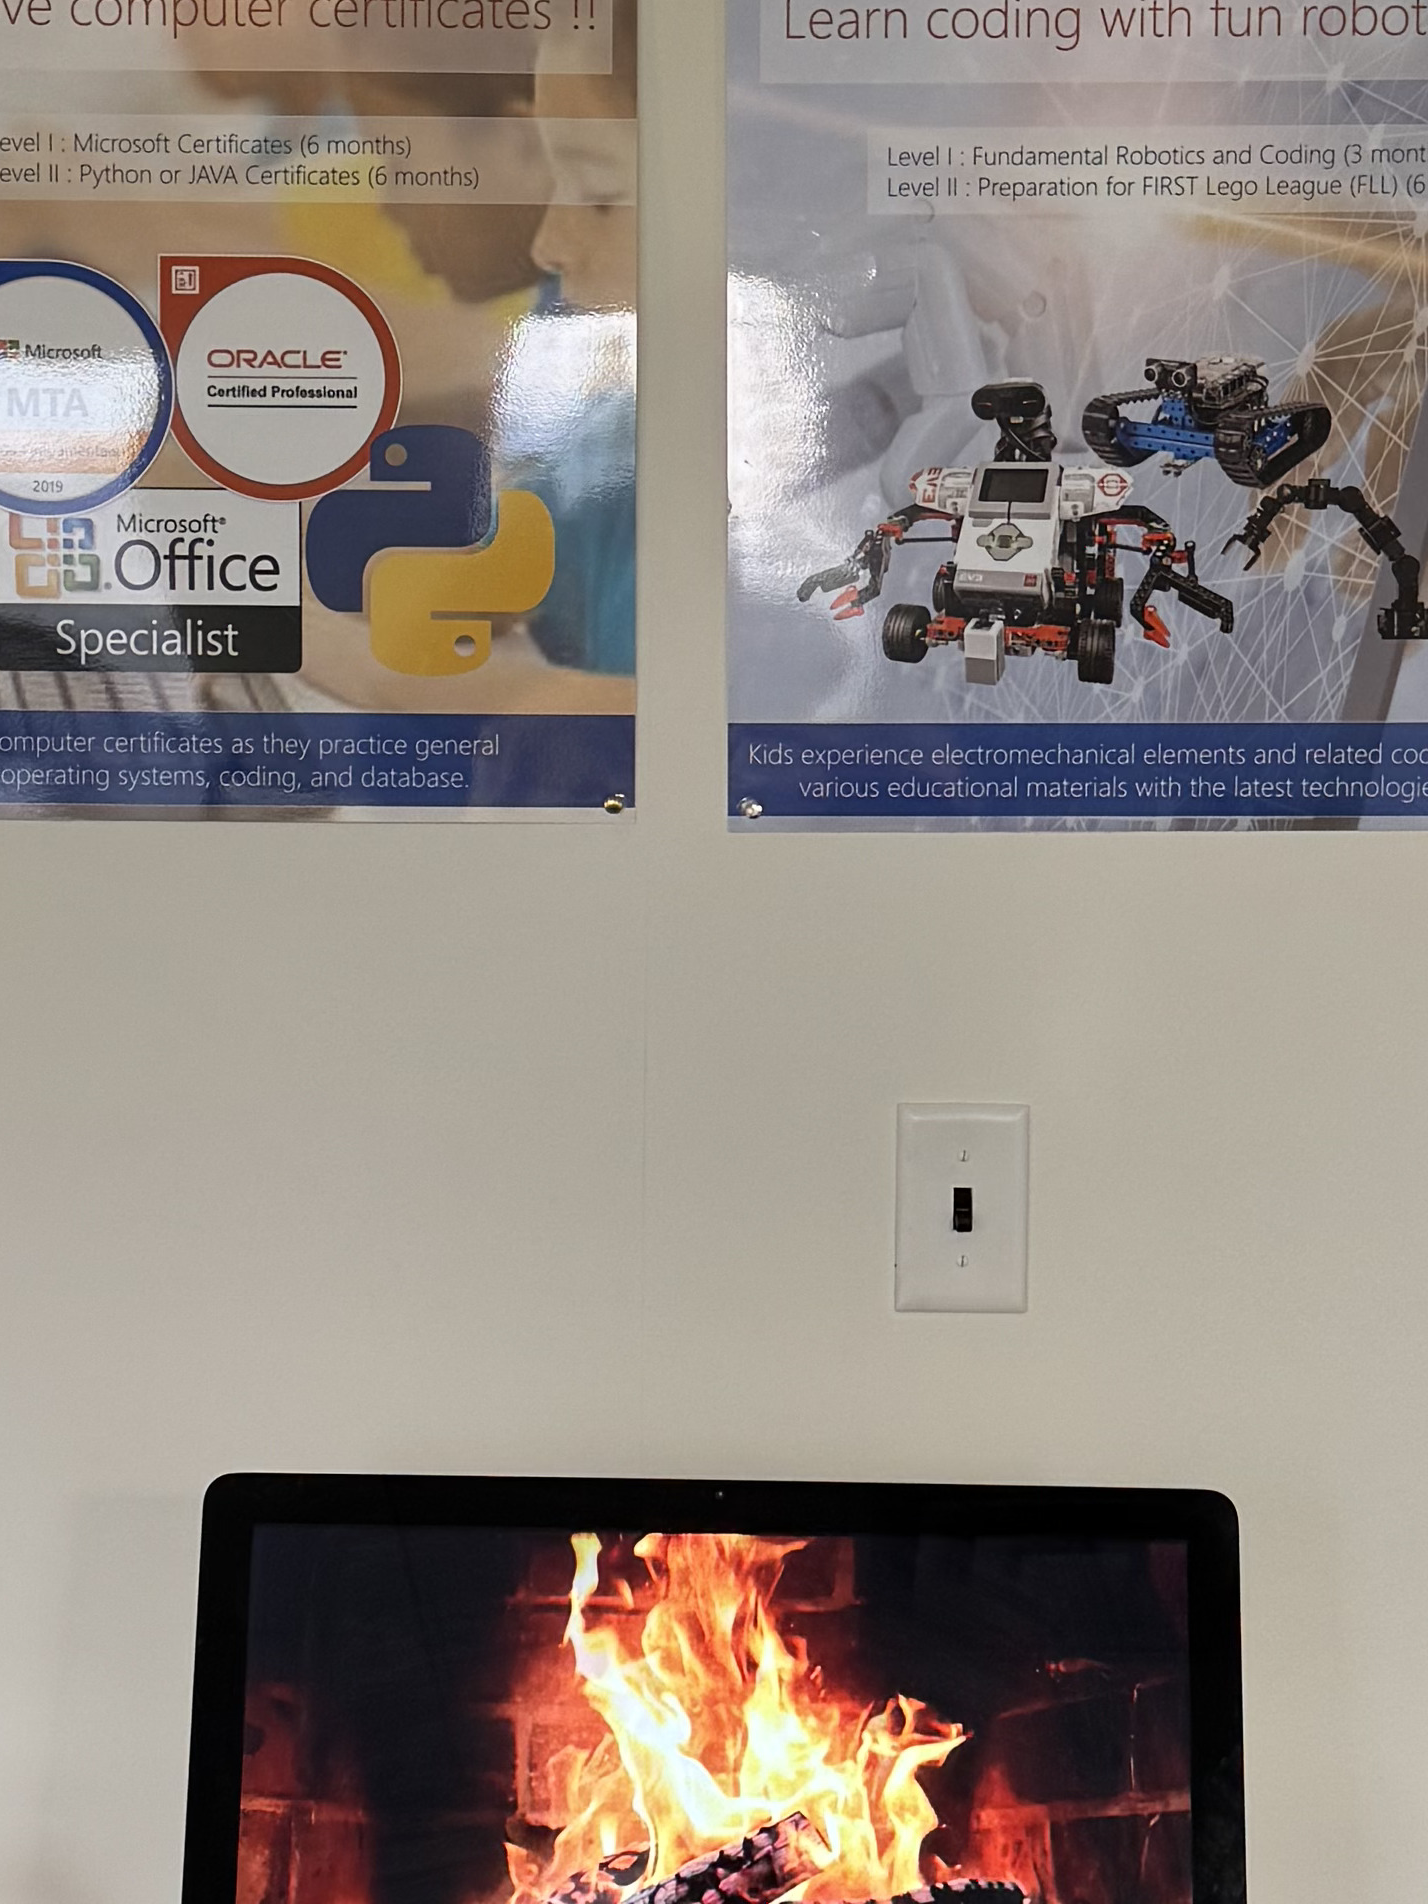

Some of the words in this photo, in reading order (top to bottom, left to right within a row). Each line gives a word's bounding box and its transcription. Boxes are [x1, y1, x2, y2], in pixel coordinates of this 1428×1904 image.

[48, 132, 53, 152] I
[73, 132, 171, 154] Microsoft
[177, 132, 293, 155] Certificates
[300, 134, 320, 159] (6
[326, 134, 412, 159] months)
[887, 145, 940, 167] Level
[947, 146, 952, 166] I
[972, 144, 1109, 167] Fundamental
[1116, 144, 1206, 166] Robotics
[1212, 144, 1252, 166] and
[1259, 143, 1336, 171] Coding
[1343, 143, 1363, 168] (3
[48, 163, 59, 183] II
[79, 163, 152, 190] Python
[159, 169, 182, 185] or
[188, 164, 239, 185] JAVA
[245, 163, 361, 186] Certificates
[367, 165, 388, 190] (6
[394, 166, 480, 190] months)
[887, 176, 940, 198] Level
[947, 177, 958, 197] II
[978, 176, 1098, 202] Preparation
[1105, 175, 1136, 197] for
[1142, 175, 1199, 197] FIRST
[1206, 175, 1259, 202] Lego
[1265, 175, 1343, 202] League
[1349, 174, 1398, 198] (FLL)
[1406, 173, 1426, 198] (6
[25, 342, 102, 361] Microsoft
[206, 348, 344, 370] ORACLE
[6, 387, 89, 418] MTA
[207, 385, 267, 399] Certified
[271, 385, 358, 400] Professional
[32, 479, 64, 494] 2019
[113, 537, 281, 593] Office
[55, 618, 240, 666] Specialist
[103, 730, 223, 754] certificates
[231, 737, 255, 755] as
[262, 732, 312, 761] they
[319, 736, 408, 760] practice
[415, 733, 499, 762] general
[749, 742, 794, 765] Kids
[801, 743, 924, 771] experience
[931, 742, 1135, 766] electromechanical
[1143, 742, 1246, 765] elements
[1253, 742, 1297, 765] and
[1305, 742, 1383, 765] related
[0, 766, 110, 792] operating
[118, 767, 210, 792] systems,
[219, 764, 302, 794] coding,
[310, 764, 353, 788] and
[360, 765, 469, 789] database.
